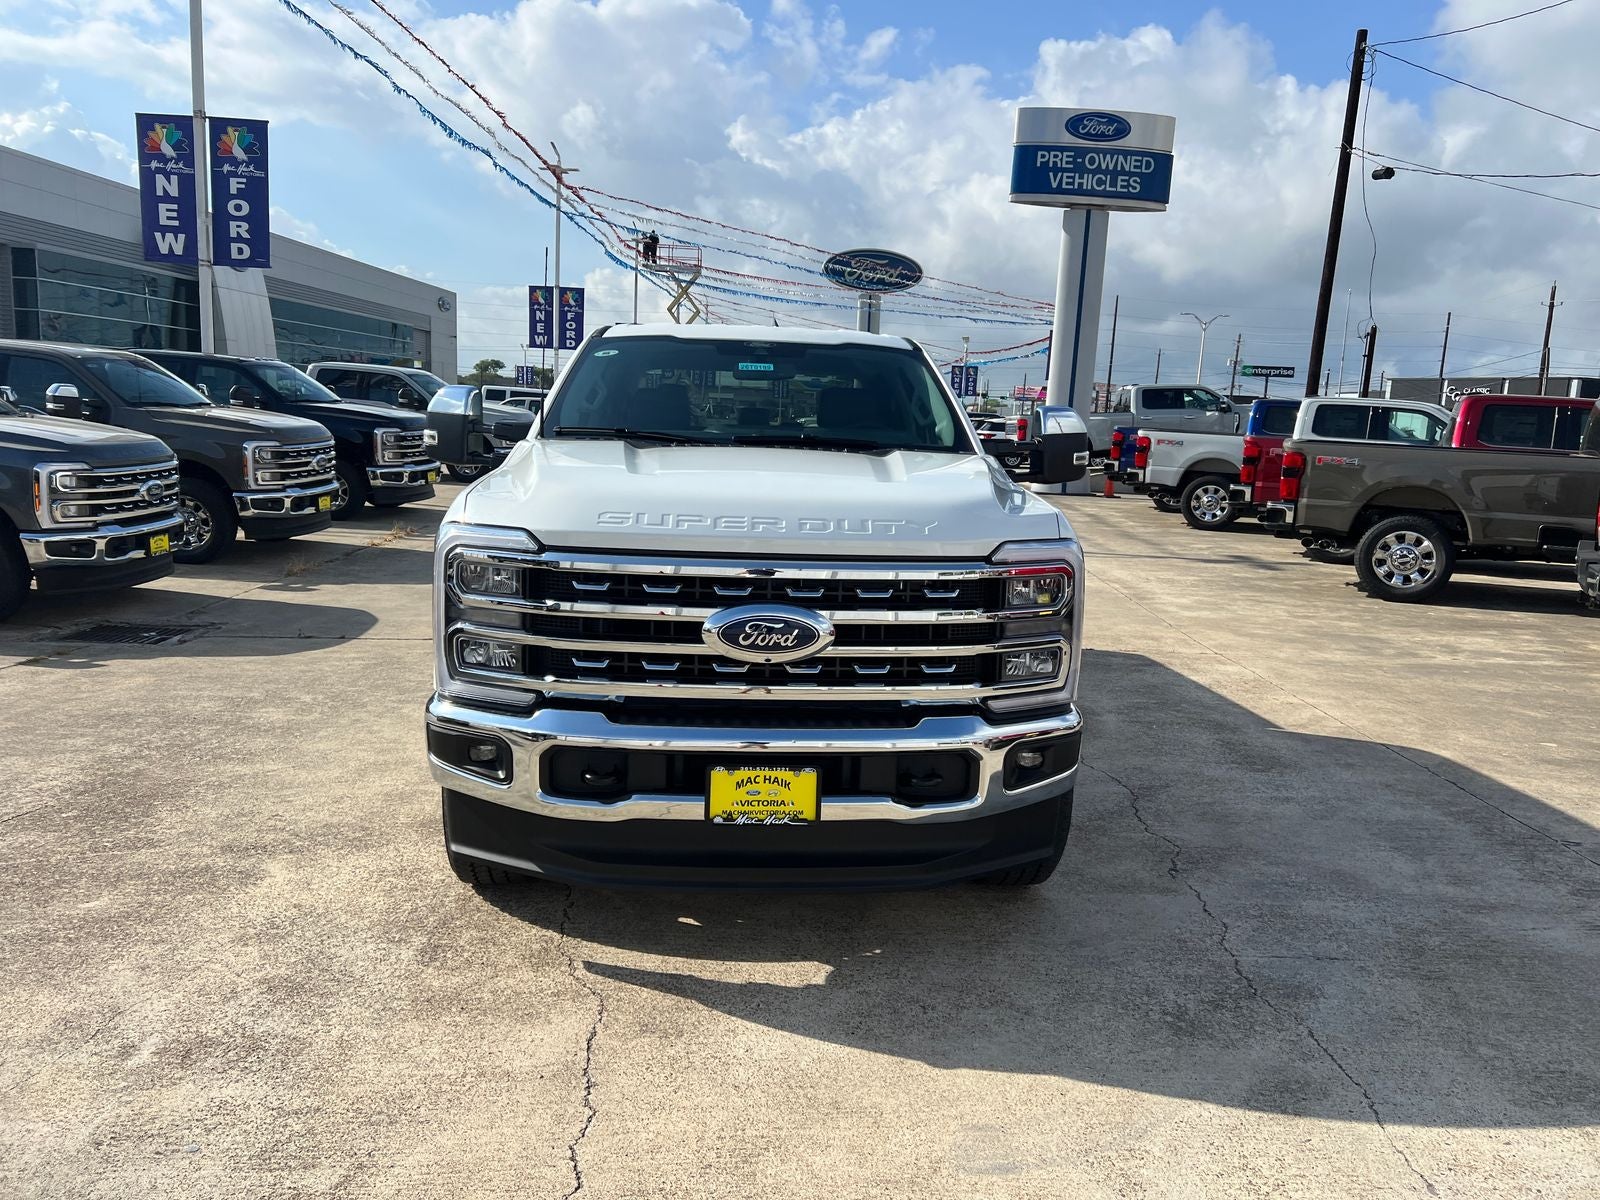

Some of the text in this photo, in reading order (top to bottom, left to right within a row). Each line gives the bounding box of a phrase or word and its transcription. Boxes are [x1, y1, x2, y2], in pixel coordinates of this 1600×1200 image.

[1079, 116, 1118, 136] Ford
[1049, 172, 1141, 193] VEHICLES
[154, 173, 186, 255] NEW
[227, 177, 251, 260] FORD
[534, 310, 548, 346] NEW
[565, 312, 576, 348] FORD
[1243, 367, 1294, 376] enterprise
[1316, 455, 1360, 466] FX4
[597, 511, 938, 536] SUPER DUTY
[738, 621, 799, 646] Ford
[735, 775, 791, 791] MAC HAIK
[740, 799, 787, 807] VICTORIA
[735, 814, 797, 825] Mac Haik
